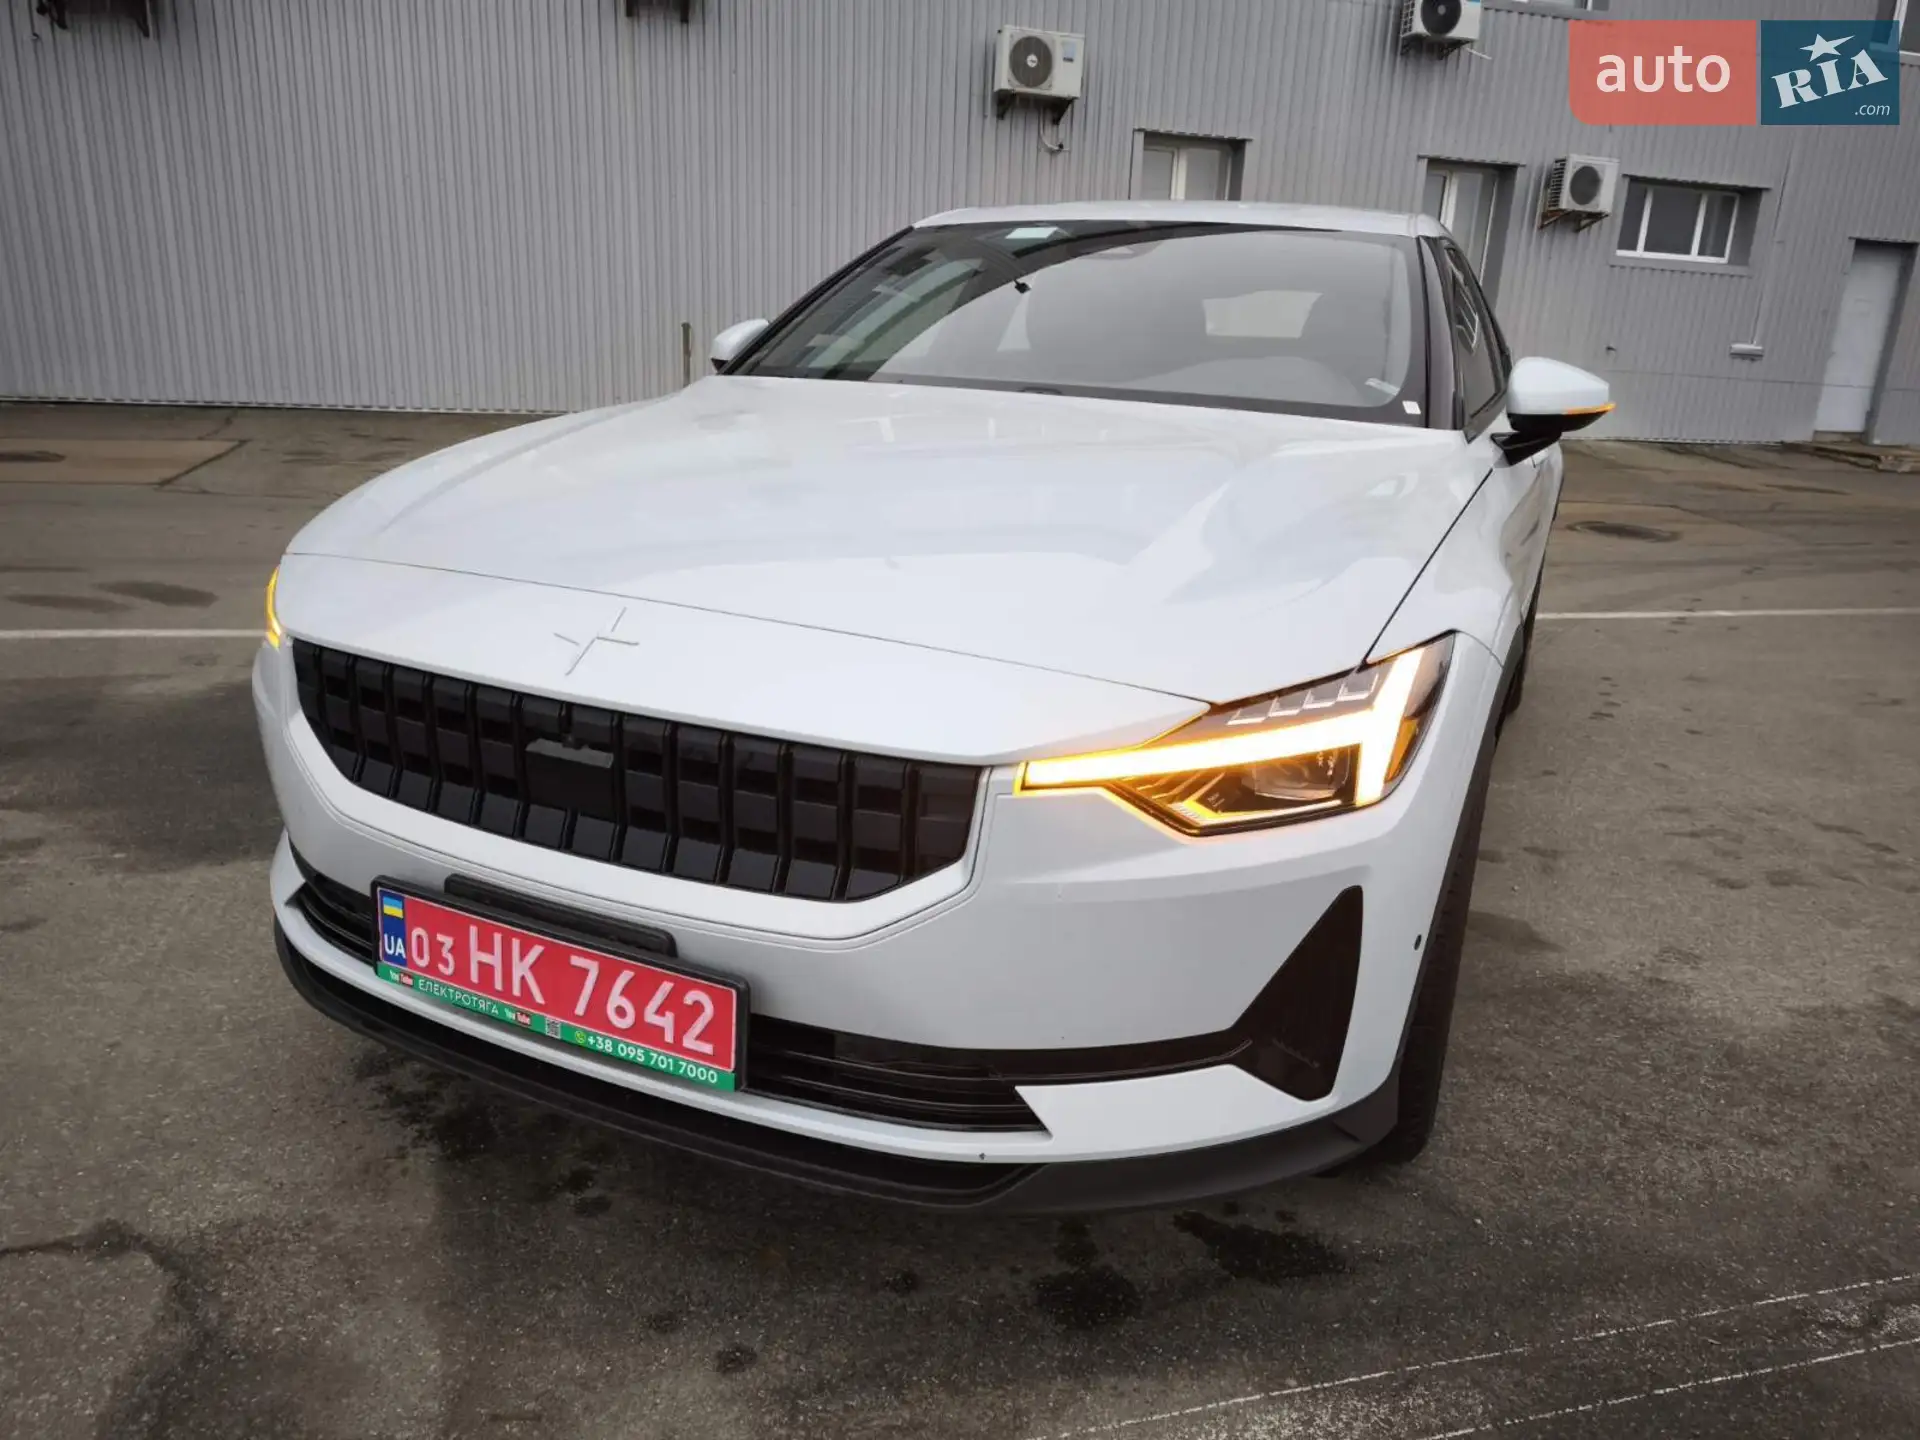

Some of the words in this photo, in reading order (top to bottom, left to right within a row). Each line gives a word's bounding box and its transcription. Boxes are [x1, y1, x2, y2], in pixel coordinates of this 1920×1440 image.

[384, 933, 407, 960] UA
[411, 927, 456, 977] 03
[469, 925, 546, 1006] HK
[569, 954, 716, 1057] 7642
[418, 978, 500, 1016] ЕЛЕКТРОТЯГА
[587, 1035, 613, 1054] +38
[617, 1043, 645, 1063] 095
[649, 1052, 674, 1072] 701
[678, 1061, 718, 1085] 7000
